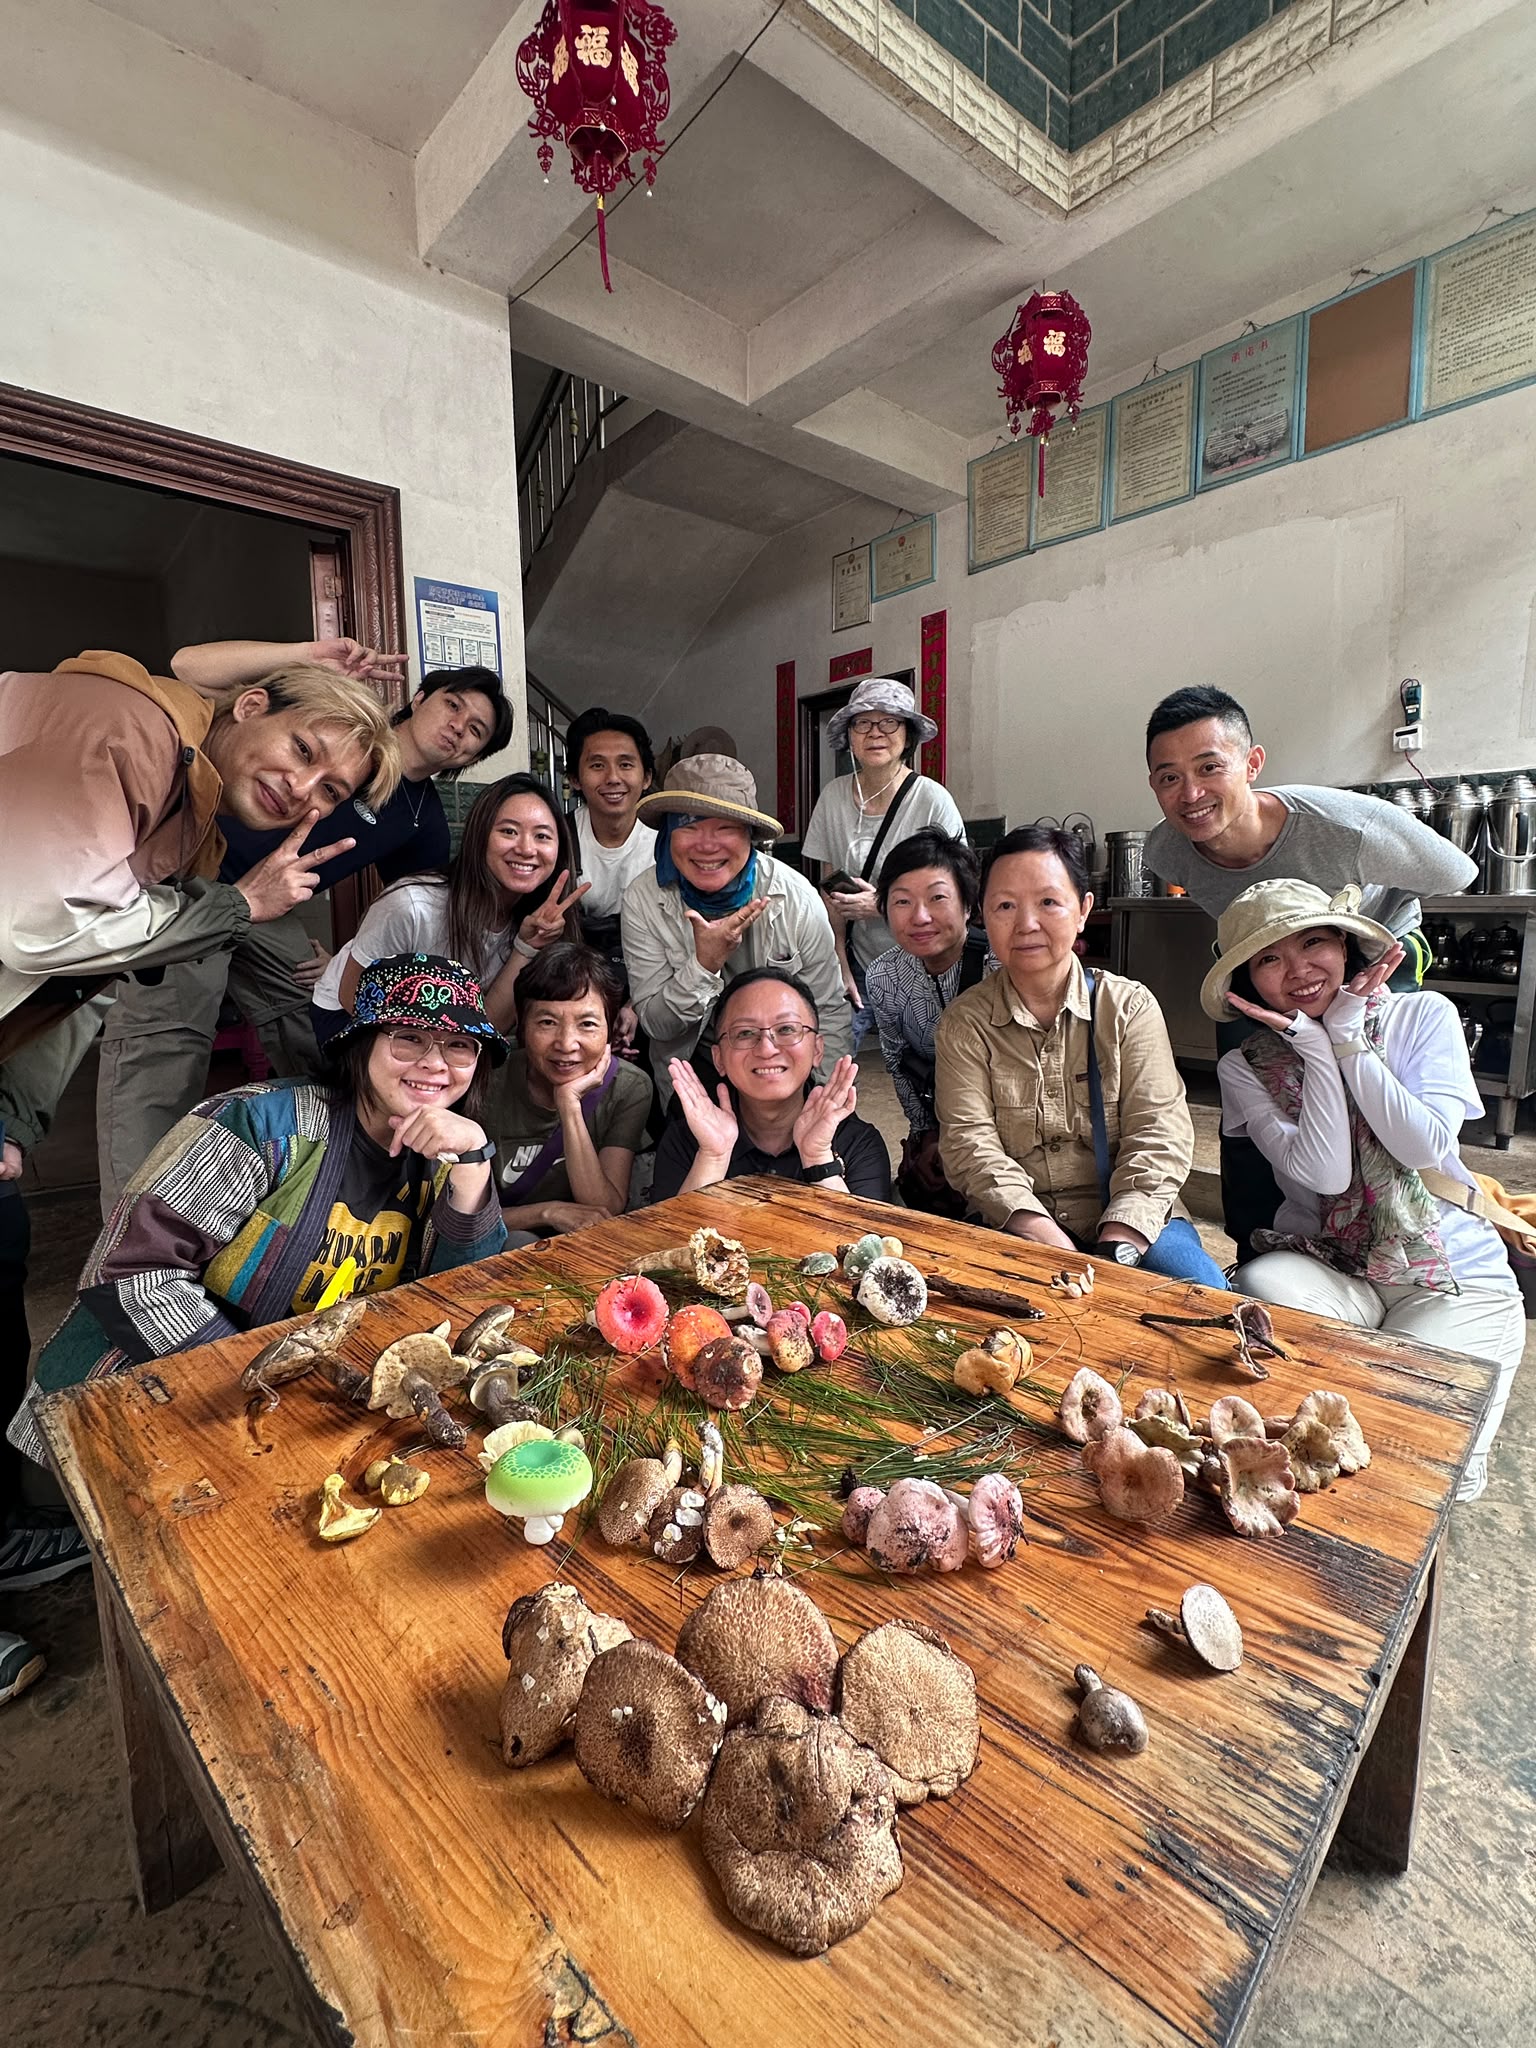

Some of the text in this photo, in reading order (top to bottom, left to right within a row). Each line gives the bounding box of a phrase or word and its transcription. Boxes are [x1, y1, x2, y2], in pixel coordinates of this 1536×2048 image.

[574, 24, 613, 68] 福
[1043, 329, 1066, 357] 福
[512, 1144, 544, 1167] NI
